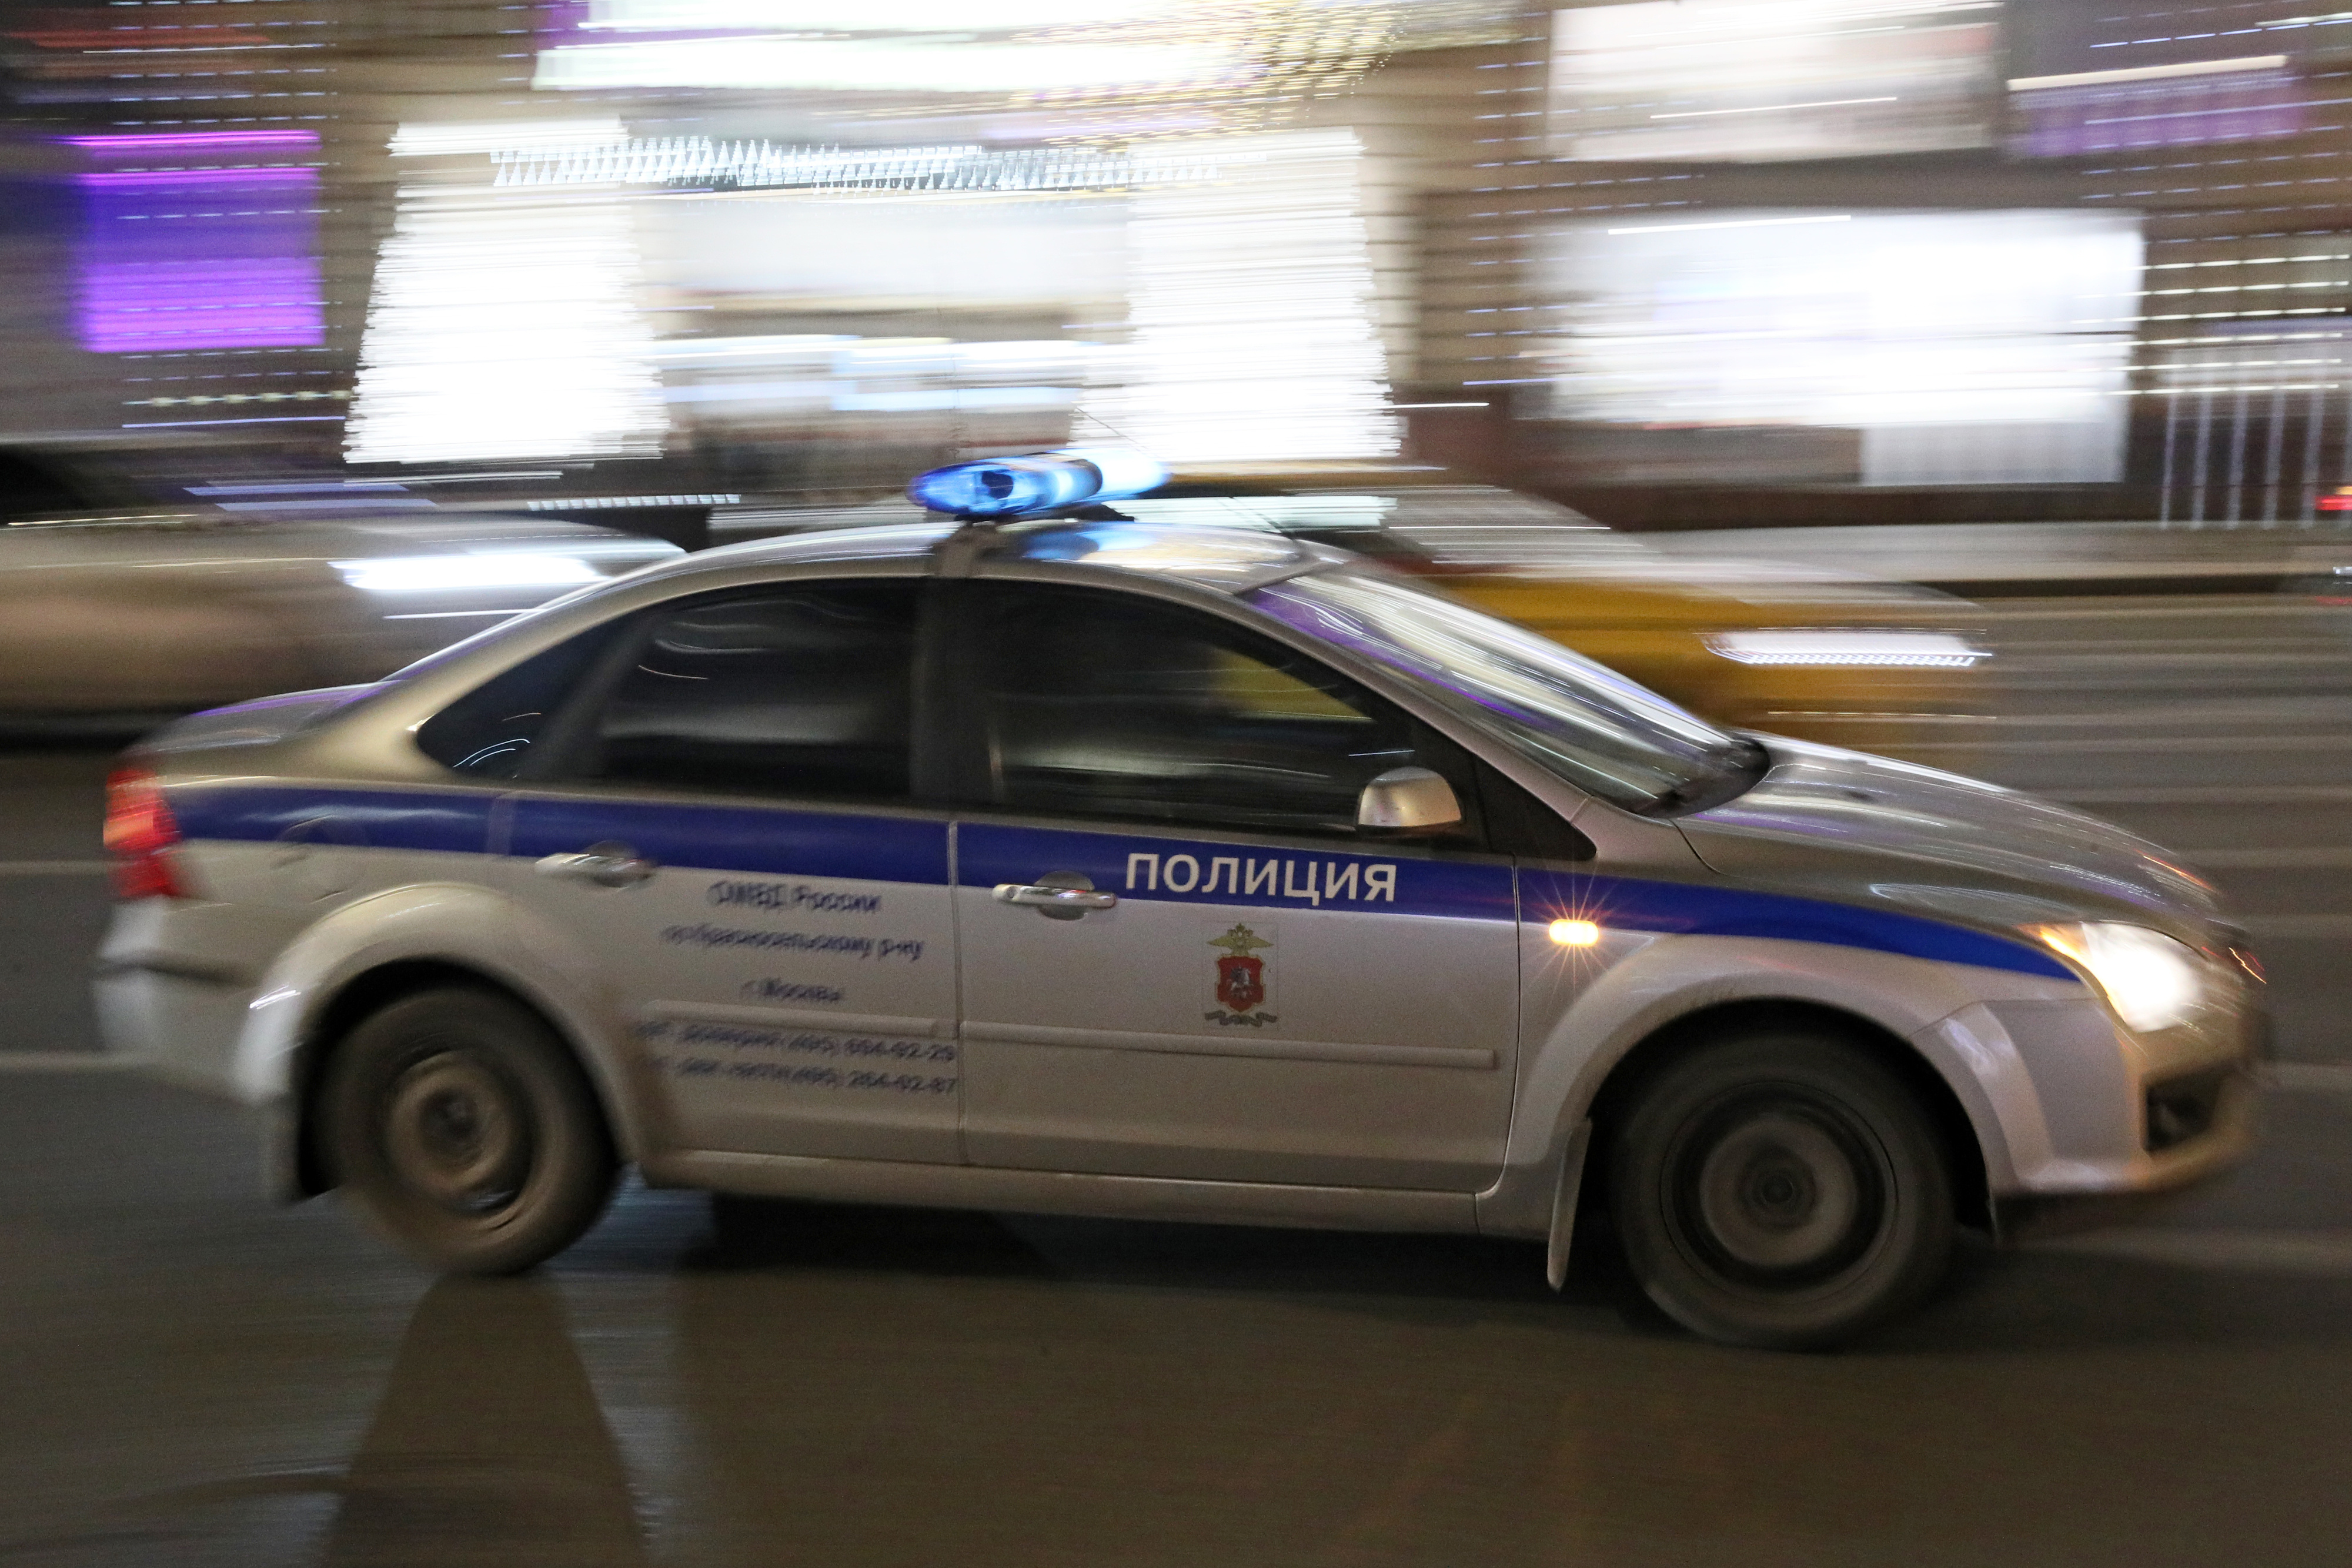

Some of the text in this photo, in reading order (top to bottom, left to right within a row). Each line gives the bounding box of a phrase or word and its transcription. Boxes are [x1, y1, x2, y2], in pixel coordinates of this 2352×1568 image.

[707, 881, 882, 912] ОМВД России
[1125, 852, 1396, 906] ПОЛИЦИЯ
